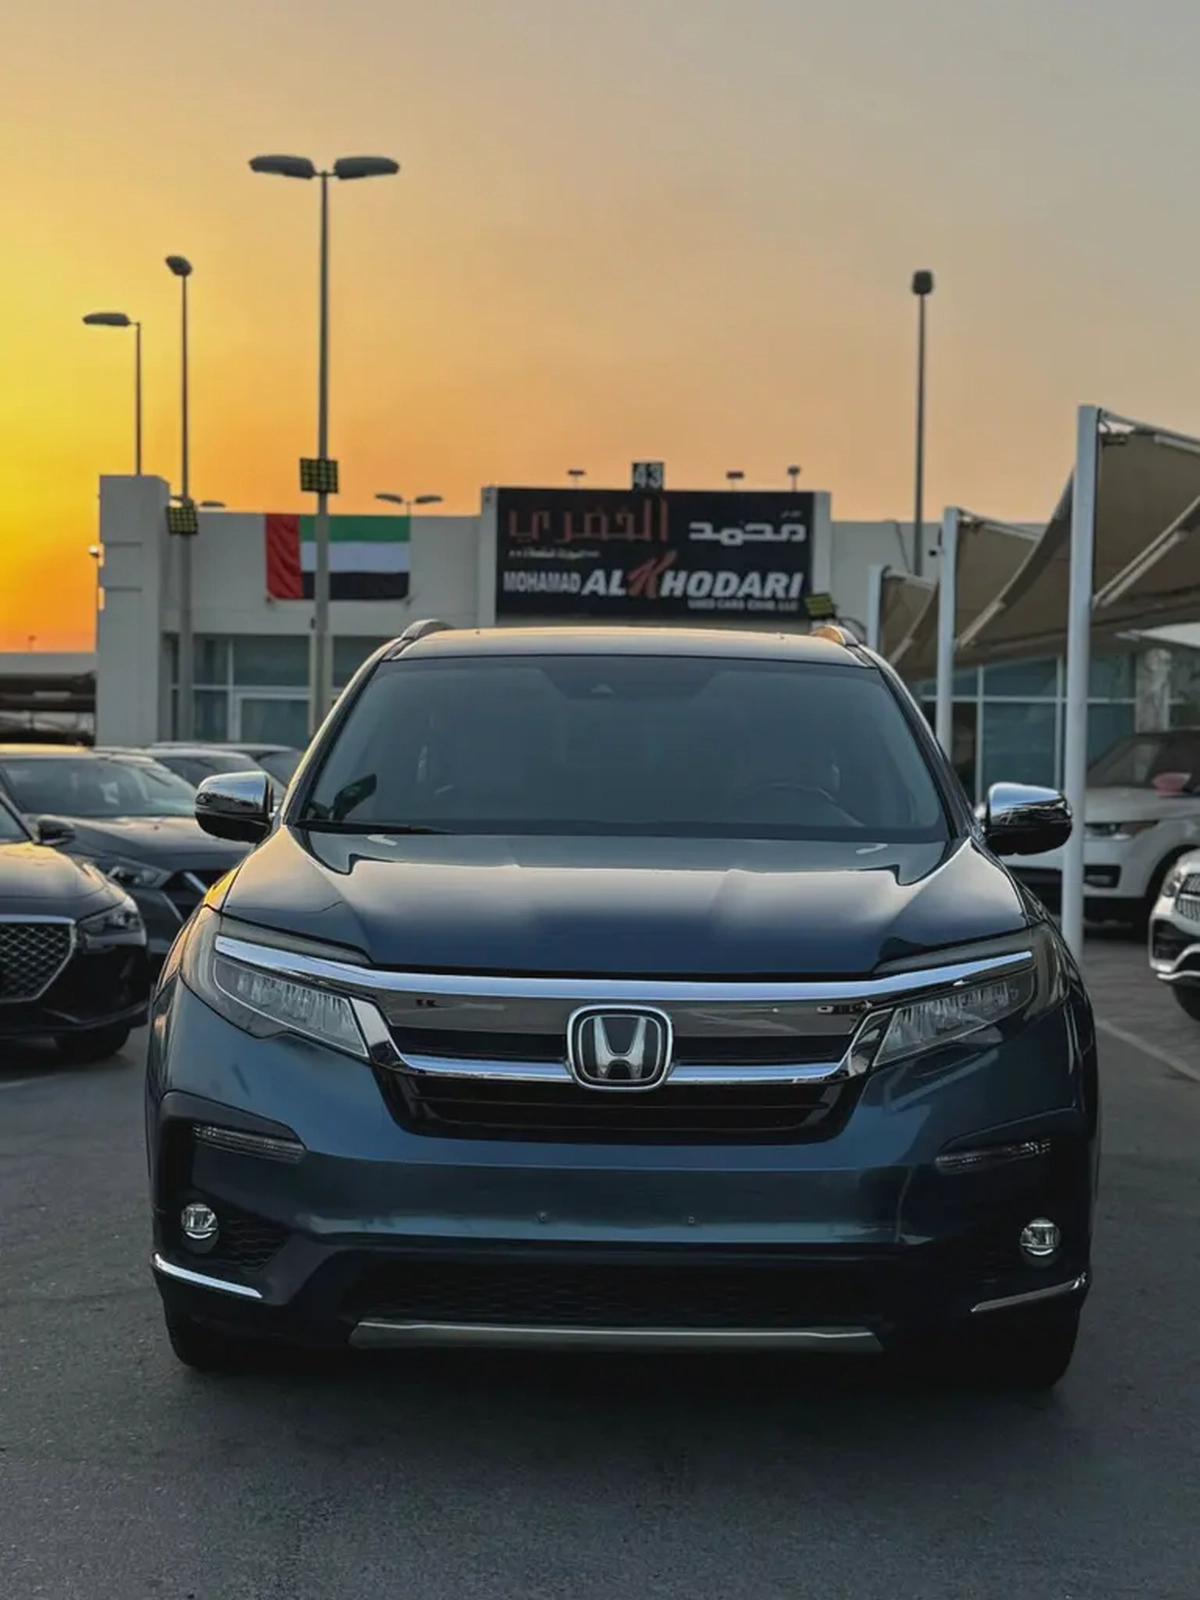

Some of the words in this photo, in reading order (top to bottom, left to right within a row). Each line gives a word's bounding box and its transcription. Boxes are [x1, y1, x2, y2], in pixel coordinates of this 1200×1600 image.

[635, 464, 662, 488] 43
[689, 521, 807, 546] محمد
[503, 572, 581, 593] MOHAMAD
[582, 569, 627, 596] AL
